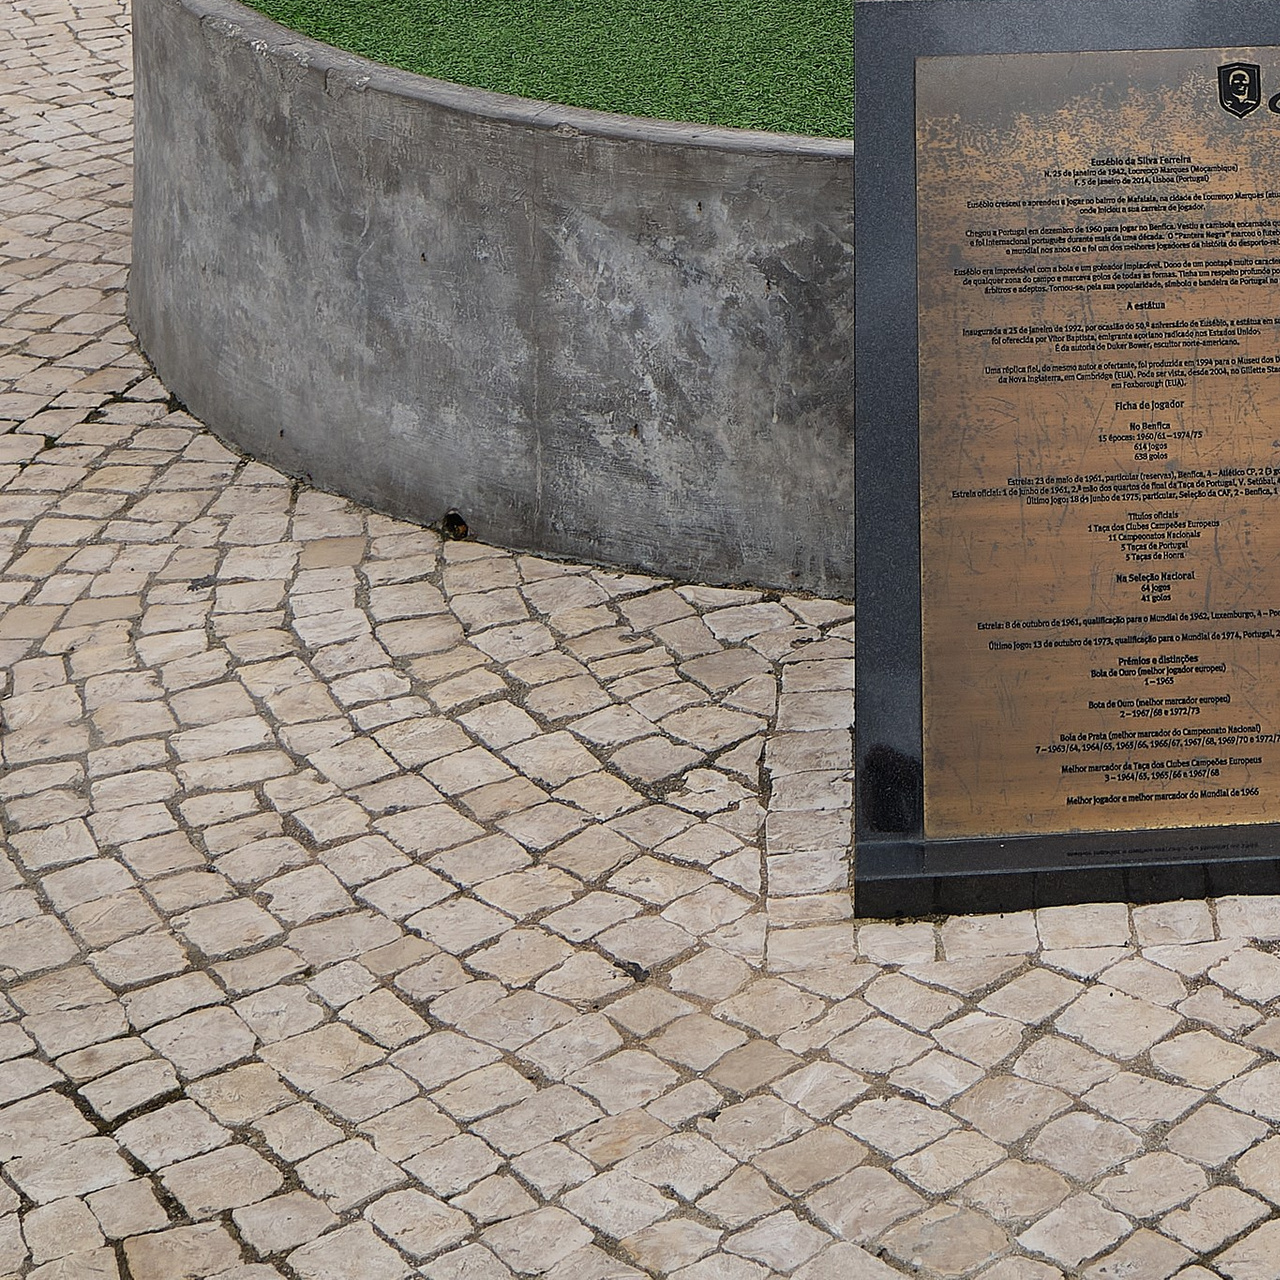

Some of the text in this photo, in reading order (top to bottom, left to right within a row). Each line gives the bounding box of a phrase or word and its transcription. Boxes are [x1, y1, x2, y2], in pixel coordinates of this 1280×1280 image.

[1124, 157, 1136, 165] da
[1137, 156, 1158, 164] Silva
[1159, 155, 1191, 163] Ferreira
[1115, 400, 1185, 410] Ficha de jogador
[1129, 421, 1170, 430] No Benfica
[1133, 442, 1167, 451] 614 jogos
[1134, 452, 1168, 461] 638 golos
[1153, 511, 1179, 519] oficiais
[1110, 523, 1124, 531] dos
[1125, 522, 1149, 530] Clubes
[1187, 519, 1220, 529] Europeus
[1107, 530, 1201, 542] 11 Campeonatos Nacionais
[1158, 541, 1188, 550] Portugal
[1162, 551, 1185, 559] Honra
[1115, 574, 1127, 582] Na
[1160, 571, 1195, 580] Nacional
[1151, 583, 1171, 592] jogos
[1151, 593, 1171, 602] golos
[1090, 669, 1107, 677] Bola
[1118, 668, 1137, 676] Ouro
[1137, 667, 1166, 676] (melhor
[1166, 665, 1194, 675] jogador
[1194, 664, 1227, 674] europeu)
